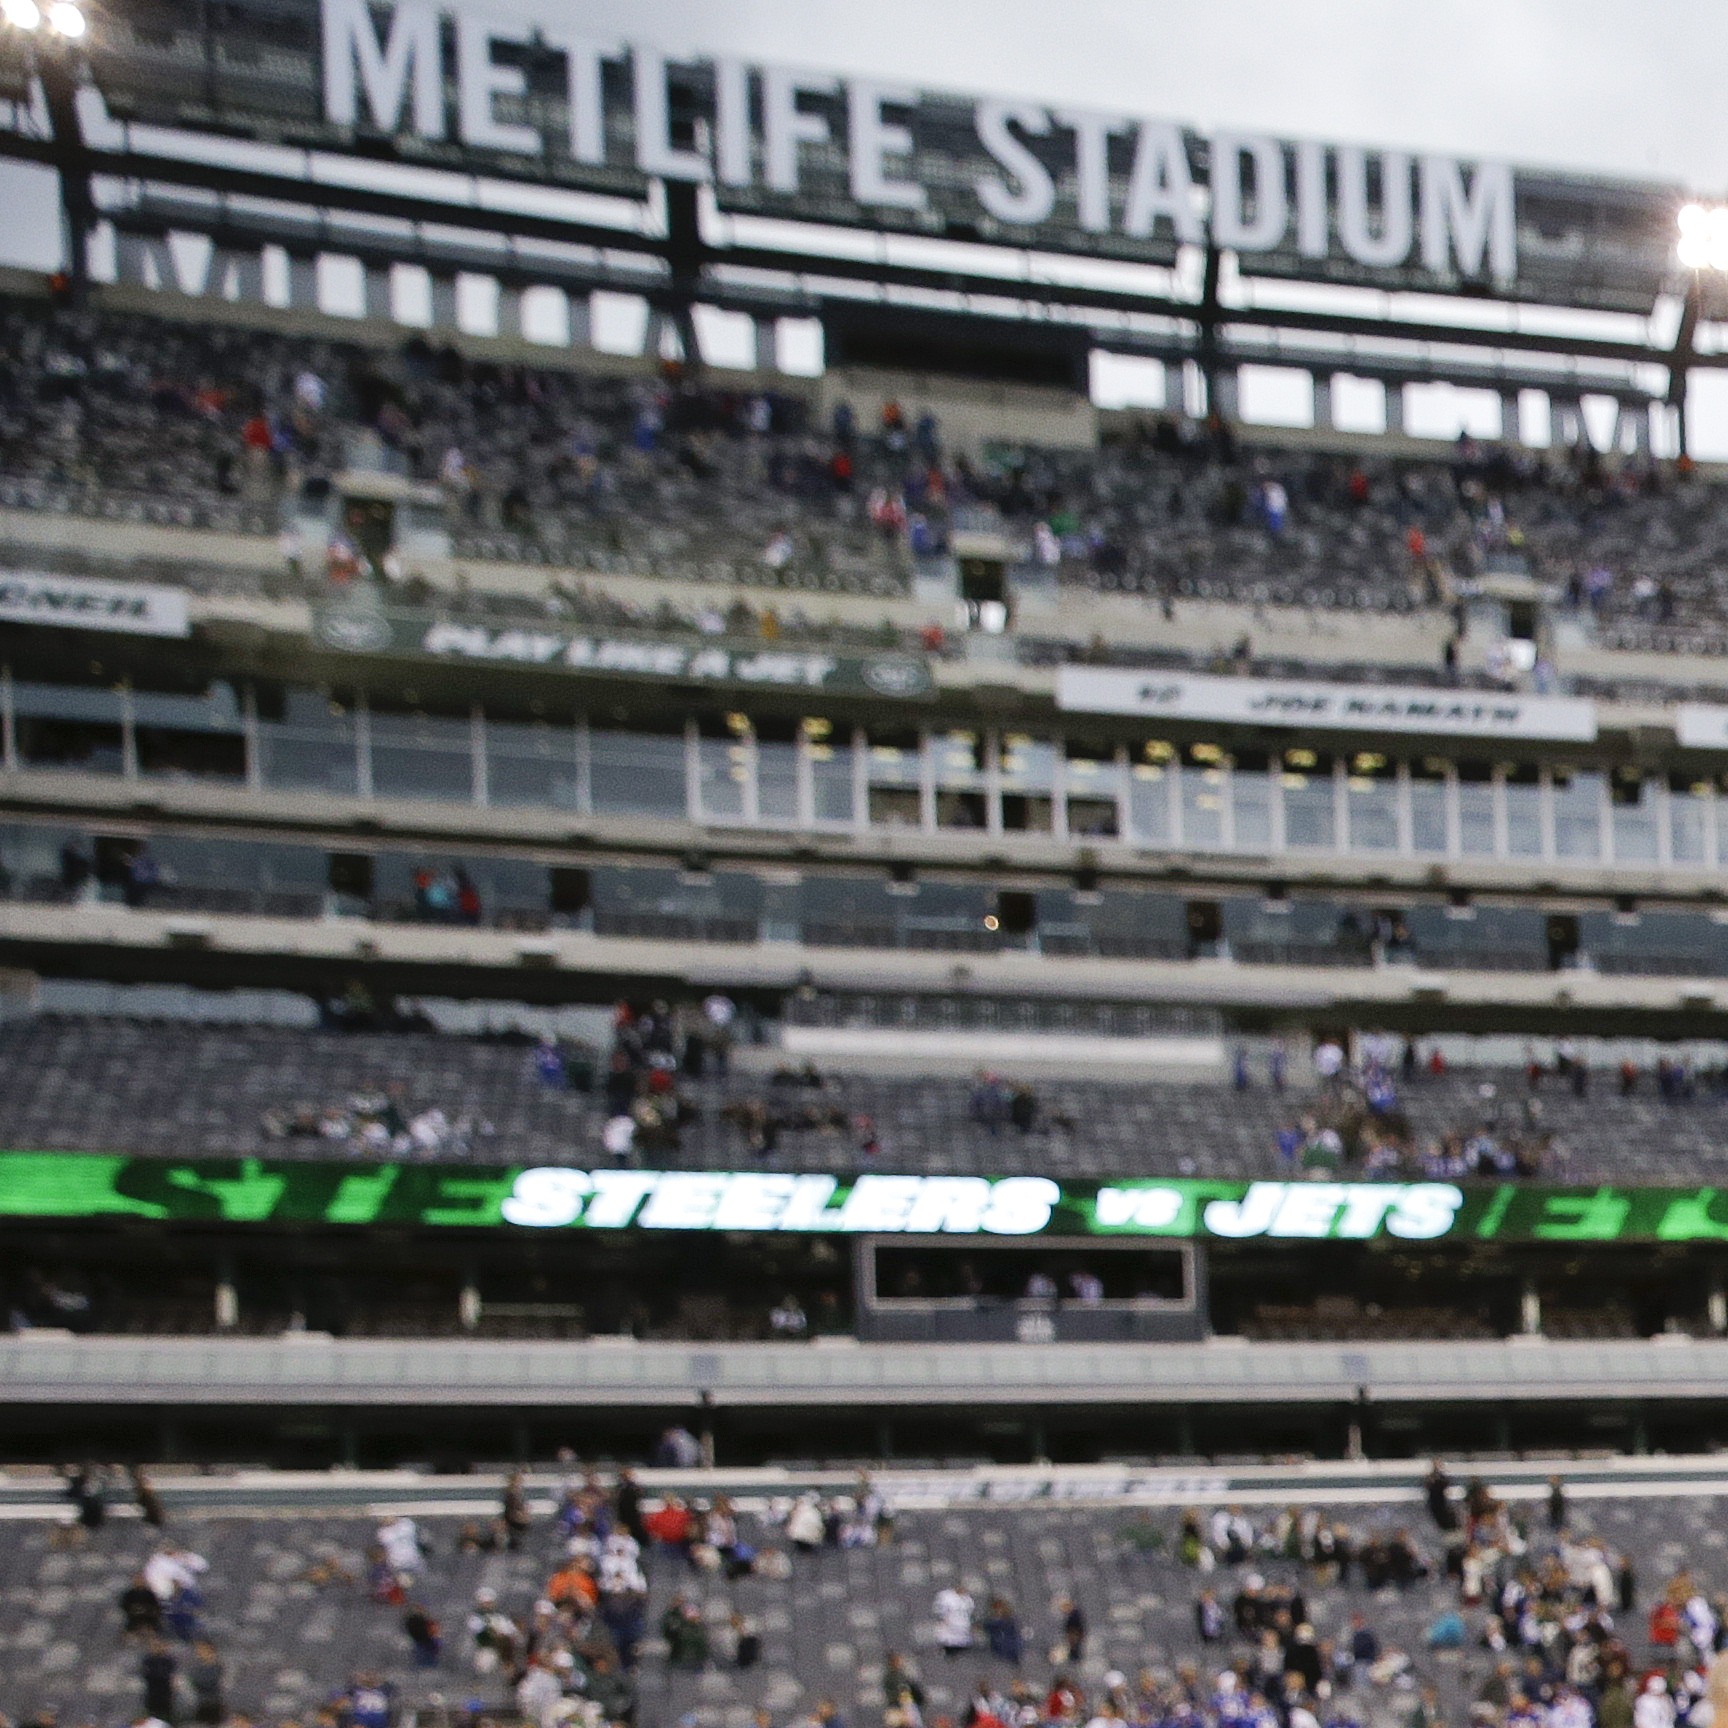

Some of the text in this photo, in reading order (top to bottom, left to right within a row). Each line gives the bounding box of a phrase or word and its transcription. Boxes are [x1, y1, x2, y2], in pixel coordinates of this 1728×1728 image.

[319, 0, 1517, 281] METLIFE STADIUM
[499, 1165, 1062, 1236] STEELERS
[1203, 1180, 1464, 1239] JETS
